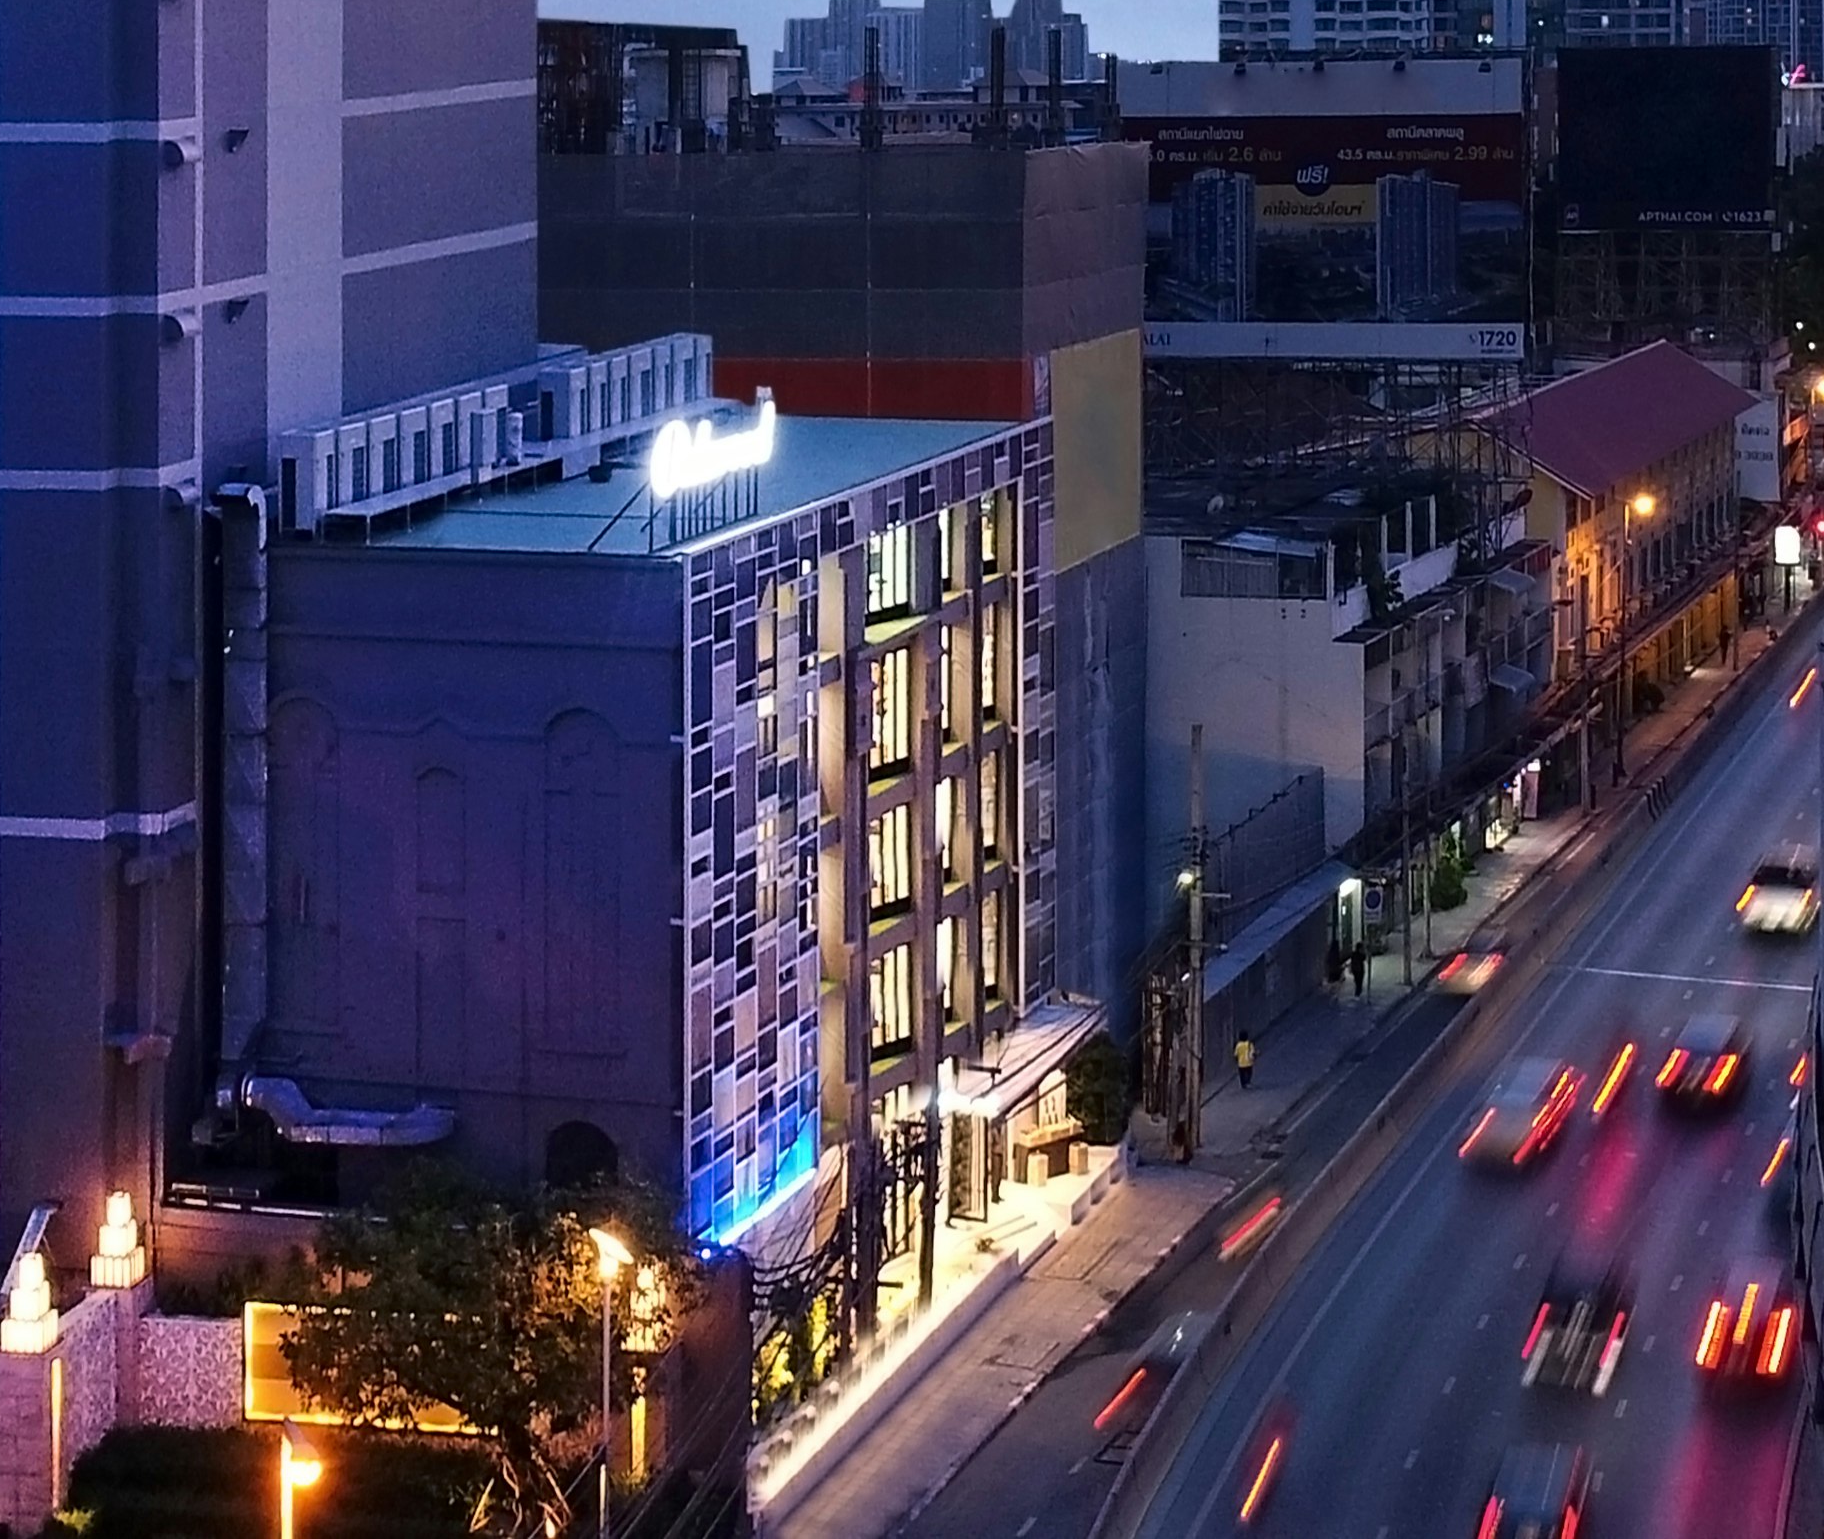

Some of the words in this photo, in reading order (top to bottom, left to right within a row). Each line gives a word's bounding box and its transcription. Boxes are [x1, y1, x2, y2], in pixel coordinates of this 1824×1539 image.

[1229, 146, 1253, 161] 2.6
[1336, 148, 1363, 160] 43.5
[1454, 145, 1487, 160] 2.99
[1296, 164, 1329, 184] ฟรี!
[1638, 211, 1713, 222] APTHAI.COM
[1734, 211, 1762, 222] 1623
[1479, 330, 1517, 347] 1720
